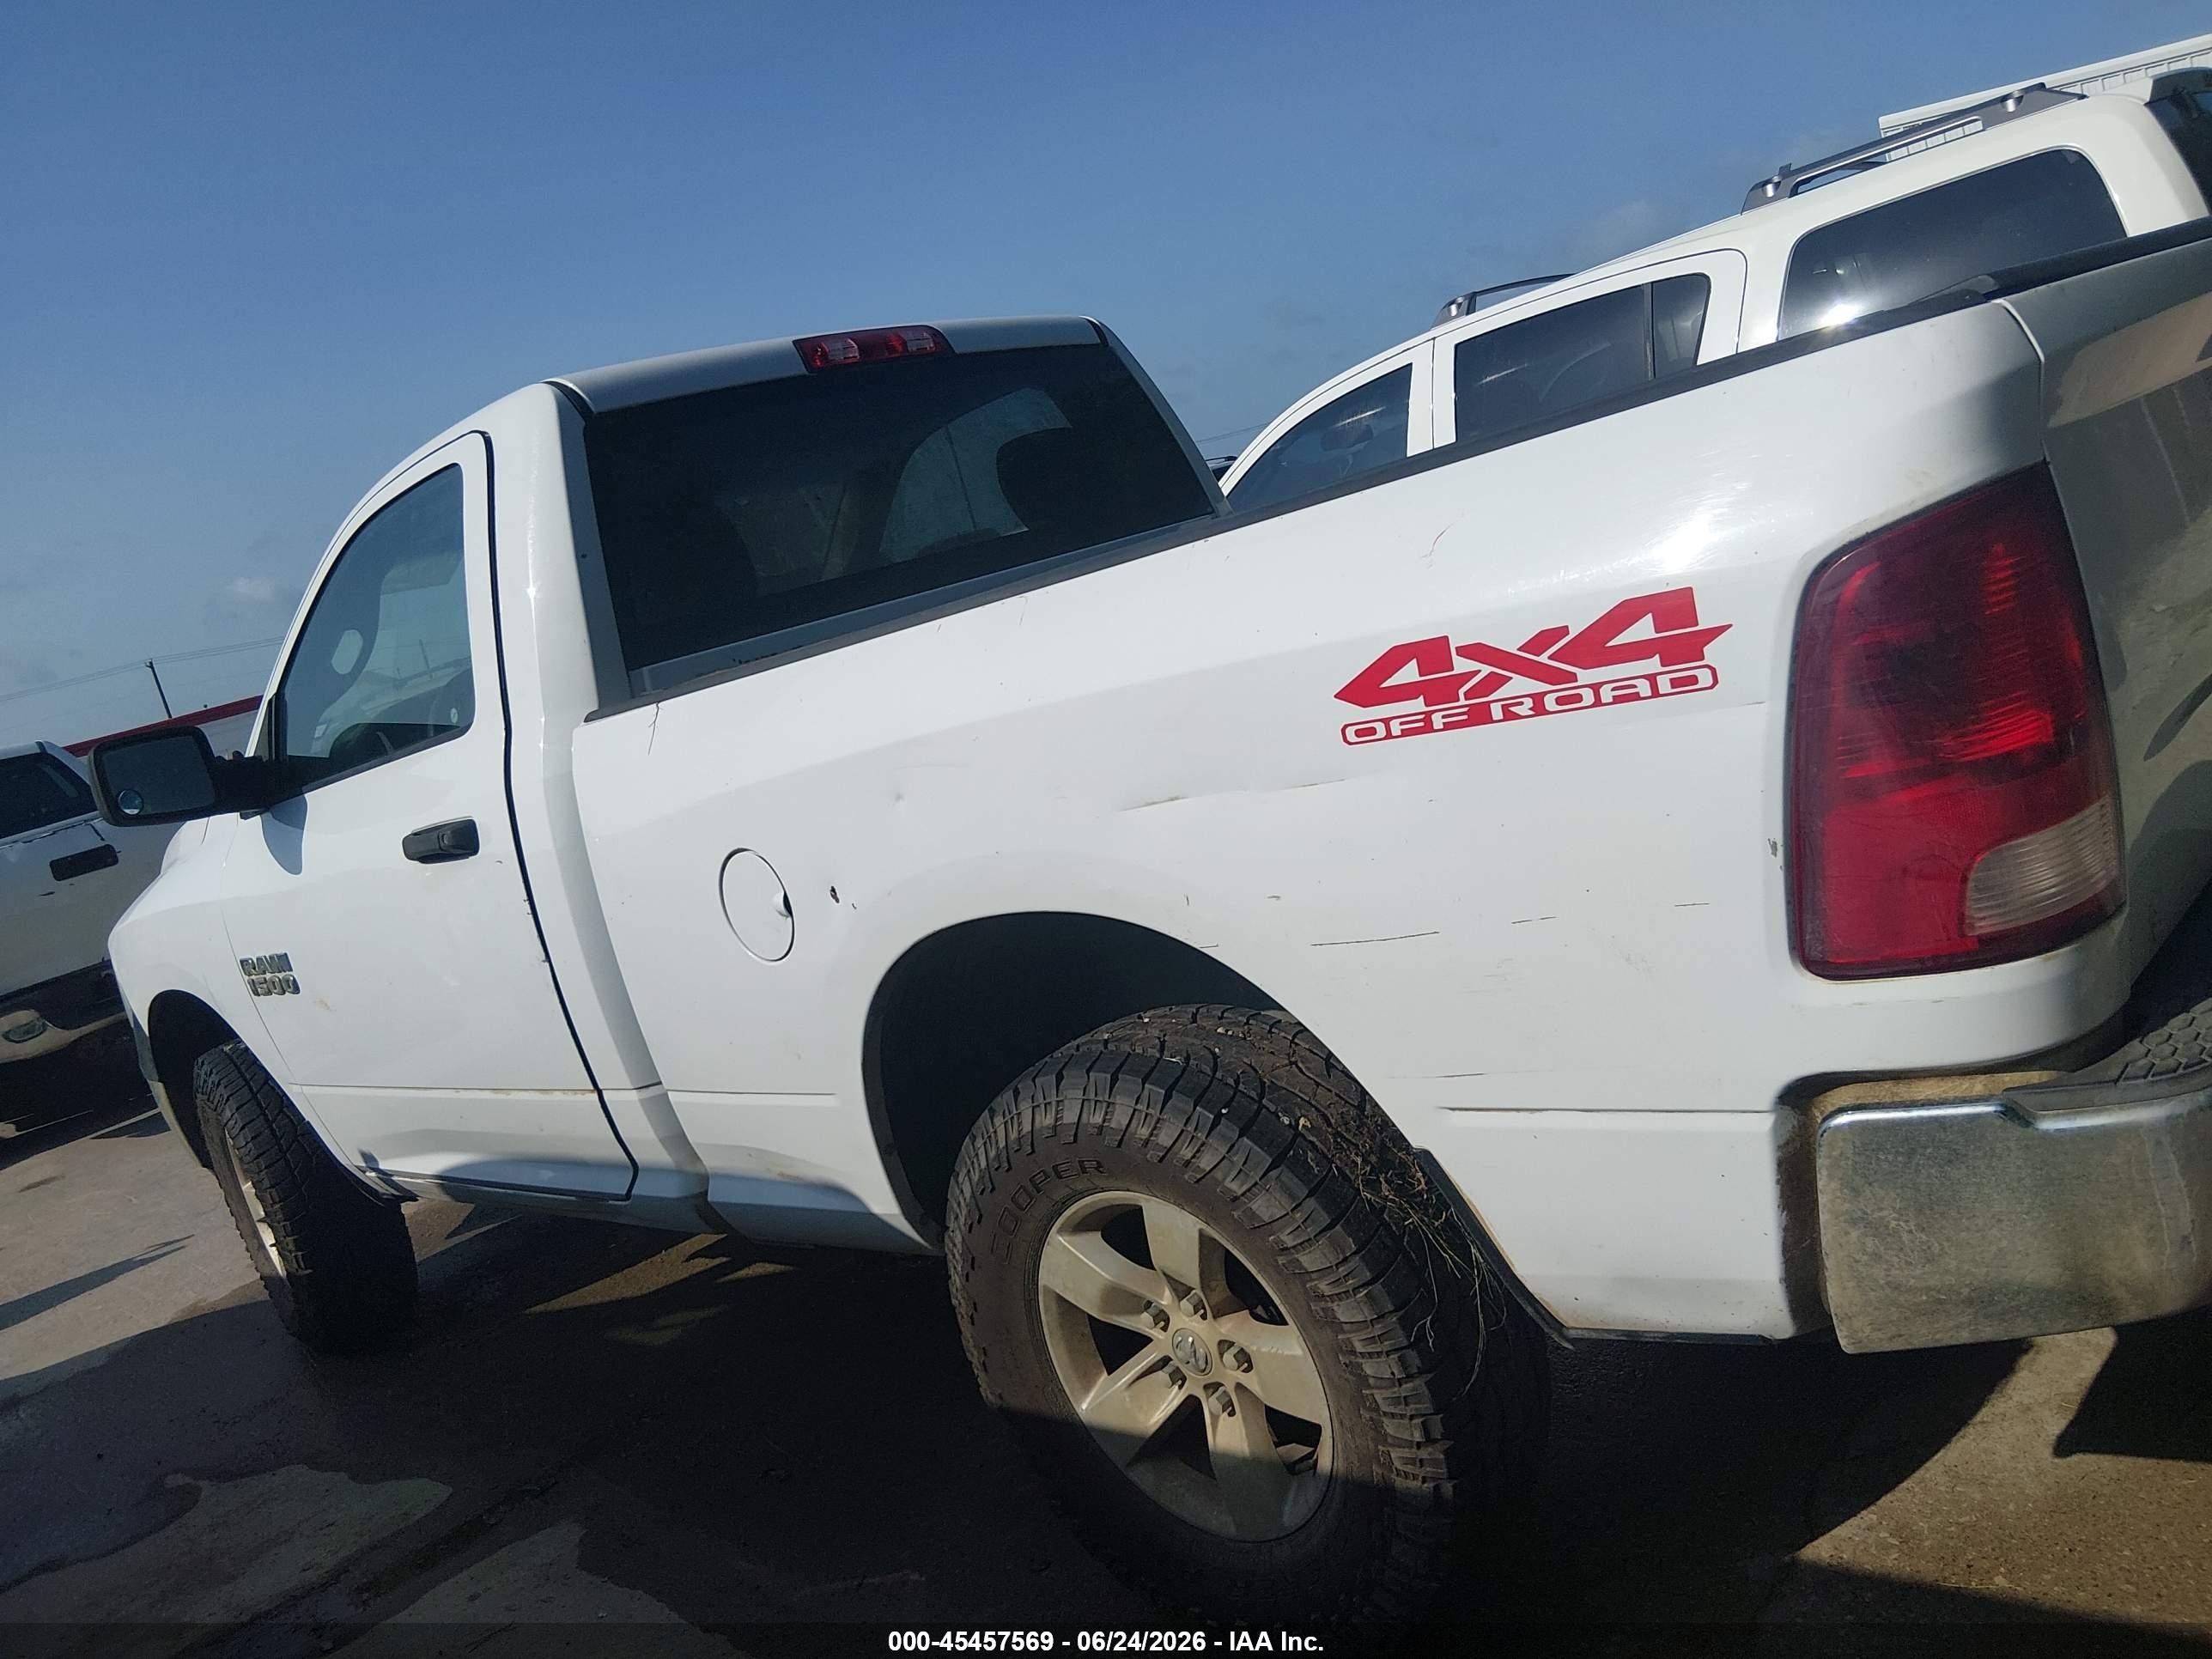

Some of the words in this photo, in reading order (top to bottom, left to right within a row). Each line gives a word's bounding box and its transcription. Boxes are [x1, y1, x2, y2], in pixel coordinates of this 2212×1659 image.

[1344, 707, 1470, 743] OFF
[1490, 671, 1717, 720] ROAD
[240, 952, 293, 976] RAM
[247, 974, 301, 997] 1500
